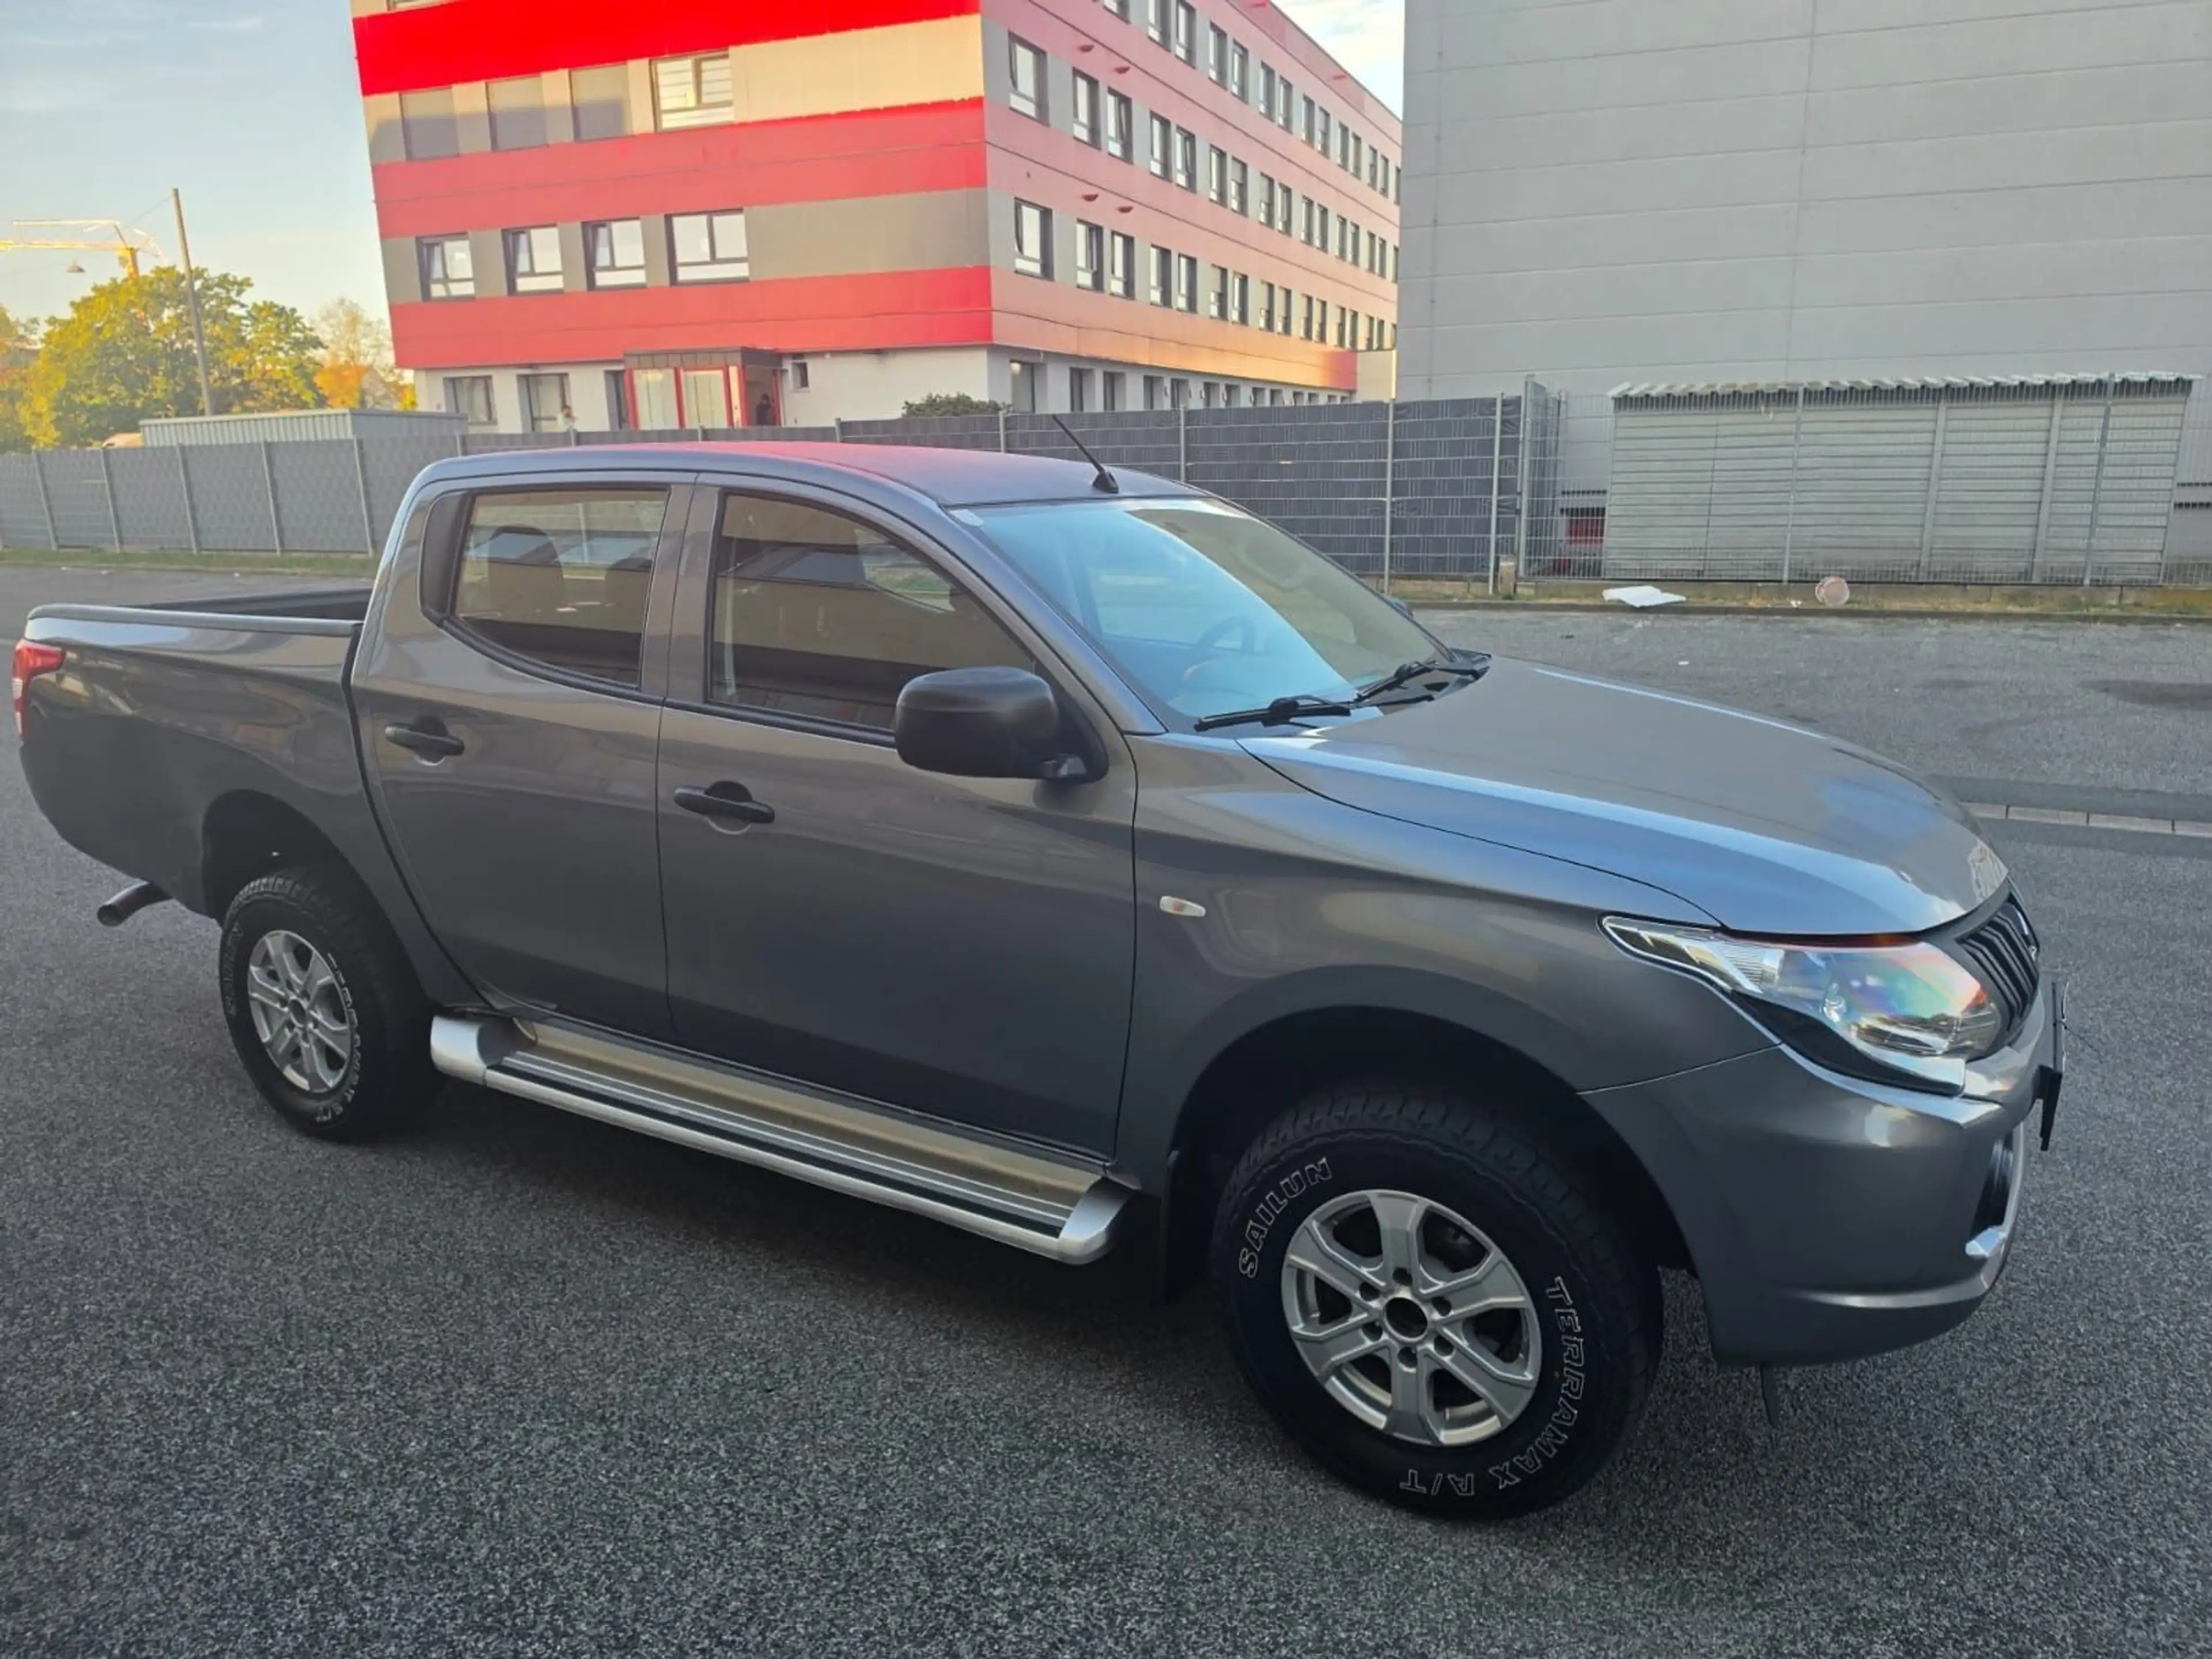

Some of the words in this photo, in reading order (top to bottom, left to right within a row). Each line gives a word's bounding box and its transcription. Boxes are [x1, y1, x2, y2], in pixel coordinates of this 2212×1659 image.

[1238, 1157, 1332, 1279] SAILUN
[1489, 1276, 1585, 1490] TERRAMAX
[1400, 1468, 1476, 1496] A/T
